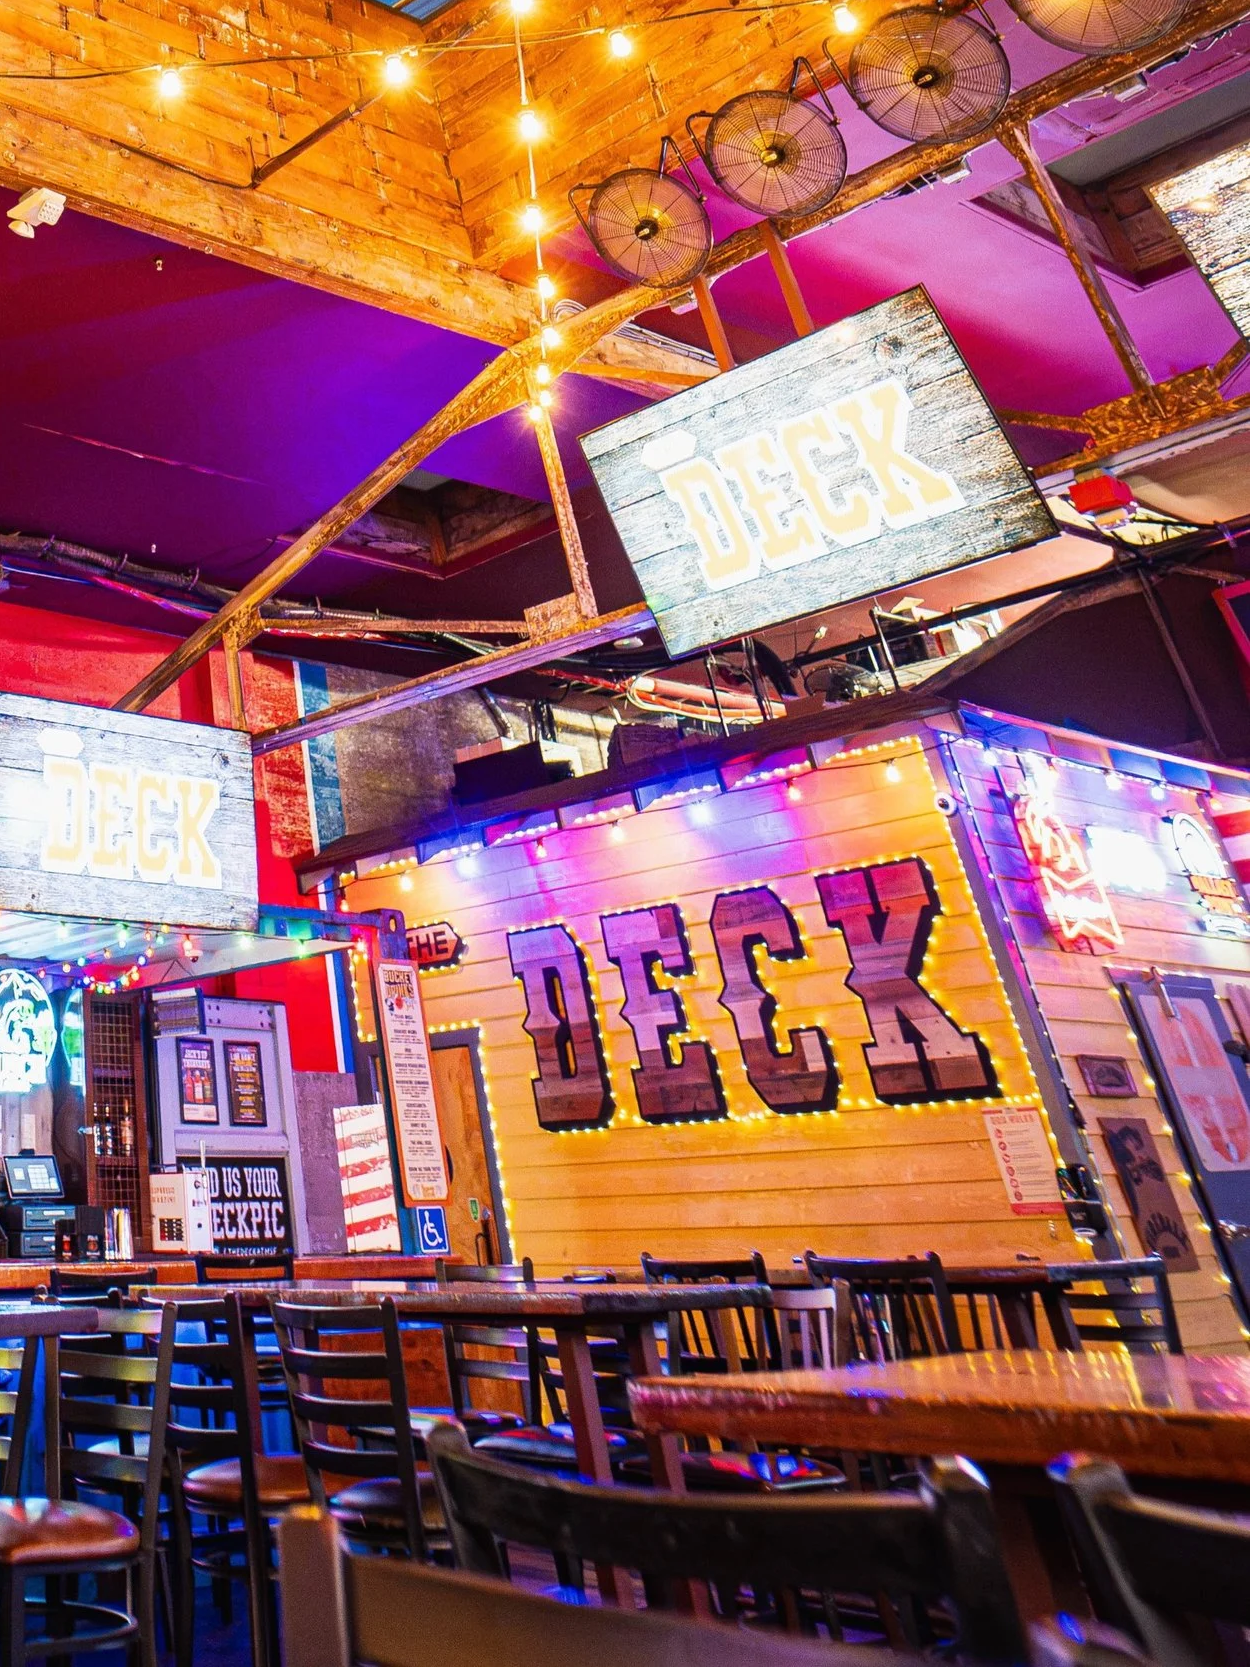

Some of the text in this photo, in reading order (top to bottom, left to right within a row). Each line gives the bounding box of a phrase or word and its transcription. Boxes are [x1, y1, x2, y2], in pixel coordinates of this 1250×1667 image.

[661, 377, 966, 591] DECK
[42, 758, 221, 889] DECK
[383, 970, 412, 985] BUCKET
[507, 856, 1002, 1132] DECK
[211, 1201, 286, 1240] ECKPIC
[222, 1167, 242, 1198] US
[243, 1167, 282, 1198] YOUR
